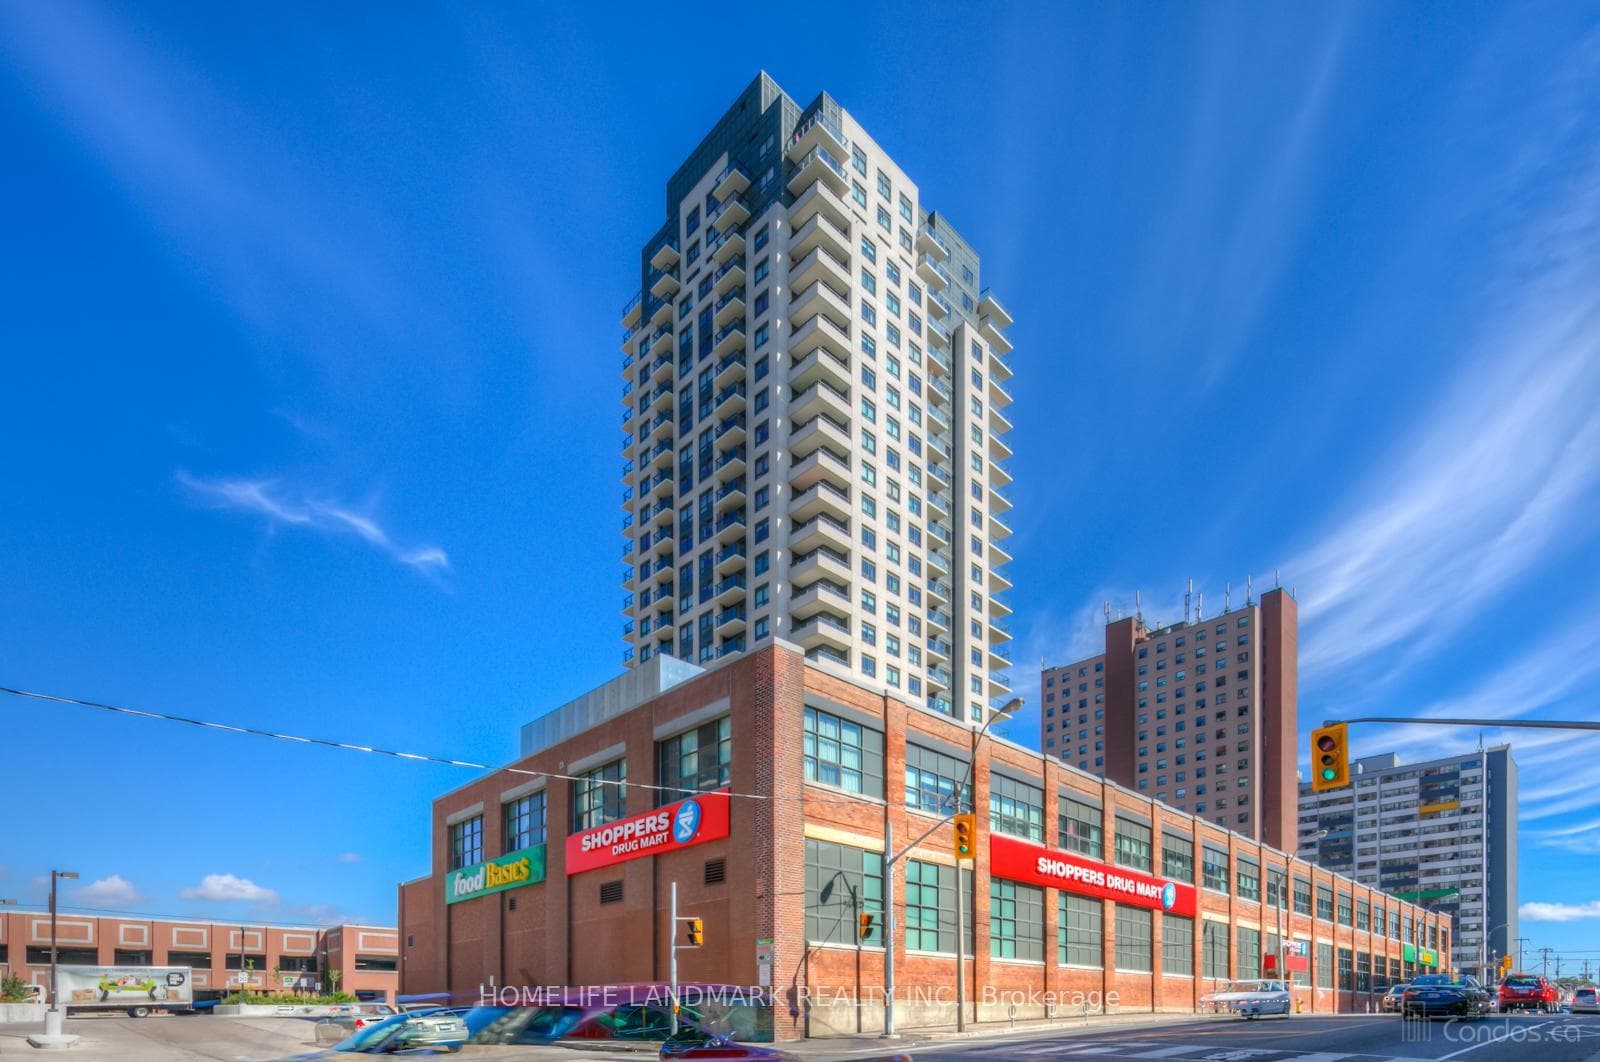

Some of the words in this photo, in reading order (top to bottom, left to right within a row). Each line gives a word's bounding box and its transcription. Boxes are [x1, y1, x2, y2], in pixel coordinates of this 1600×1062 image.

[582, 812, 669, 851] SHOPPERS
[612, 841, 638, 855] DRUG
[640, 831, 669, 848] MART
[454, 867, 485, 896] food
[1038, 857, 1105, 886] SHOPPERS
[1107, 874, 1135, 894] DRUG
[1136, 882, 1163, 899] MART
